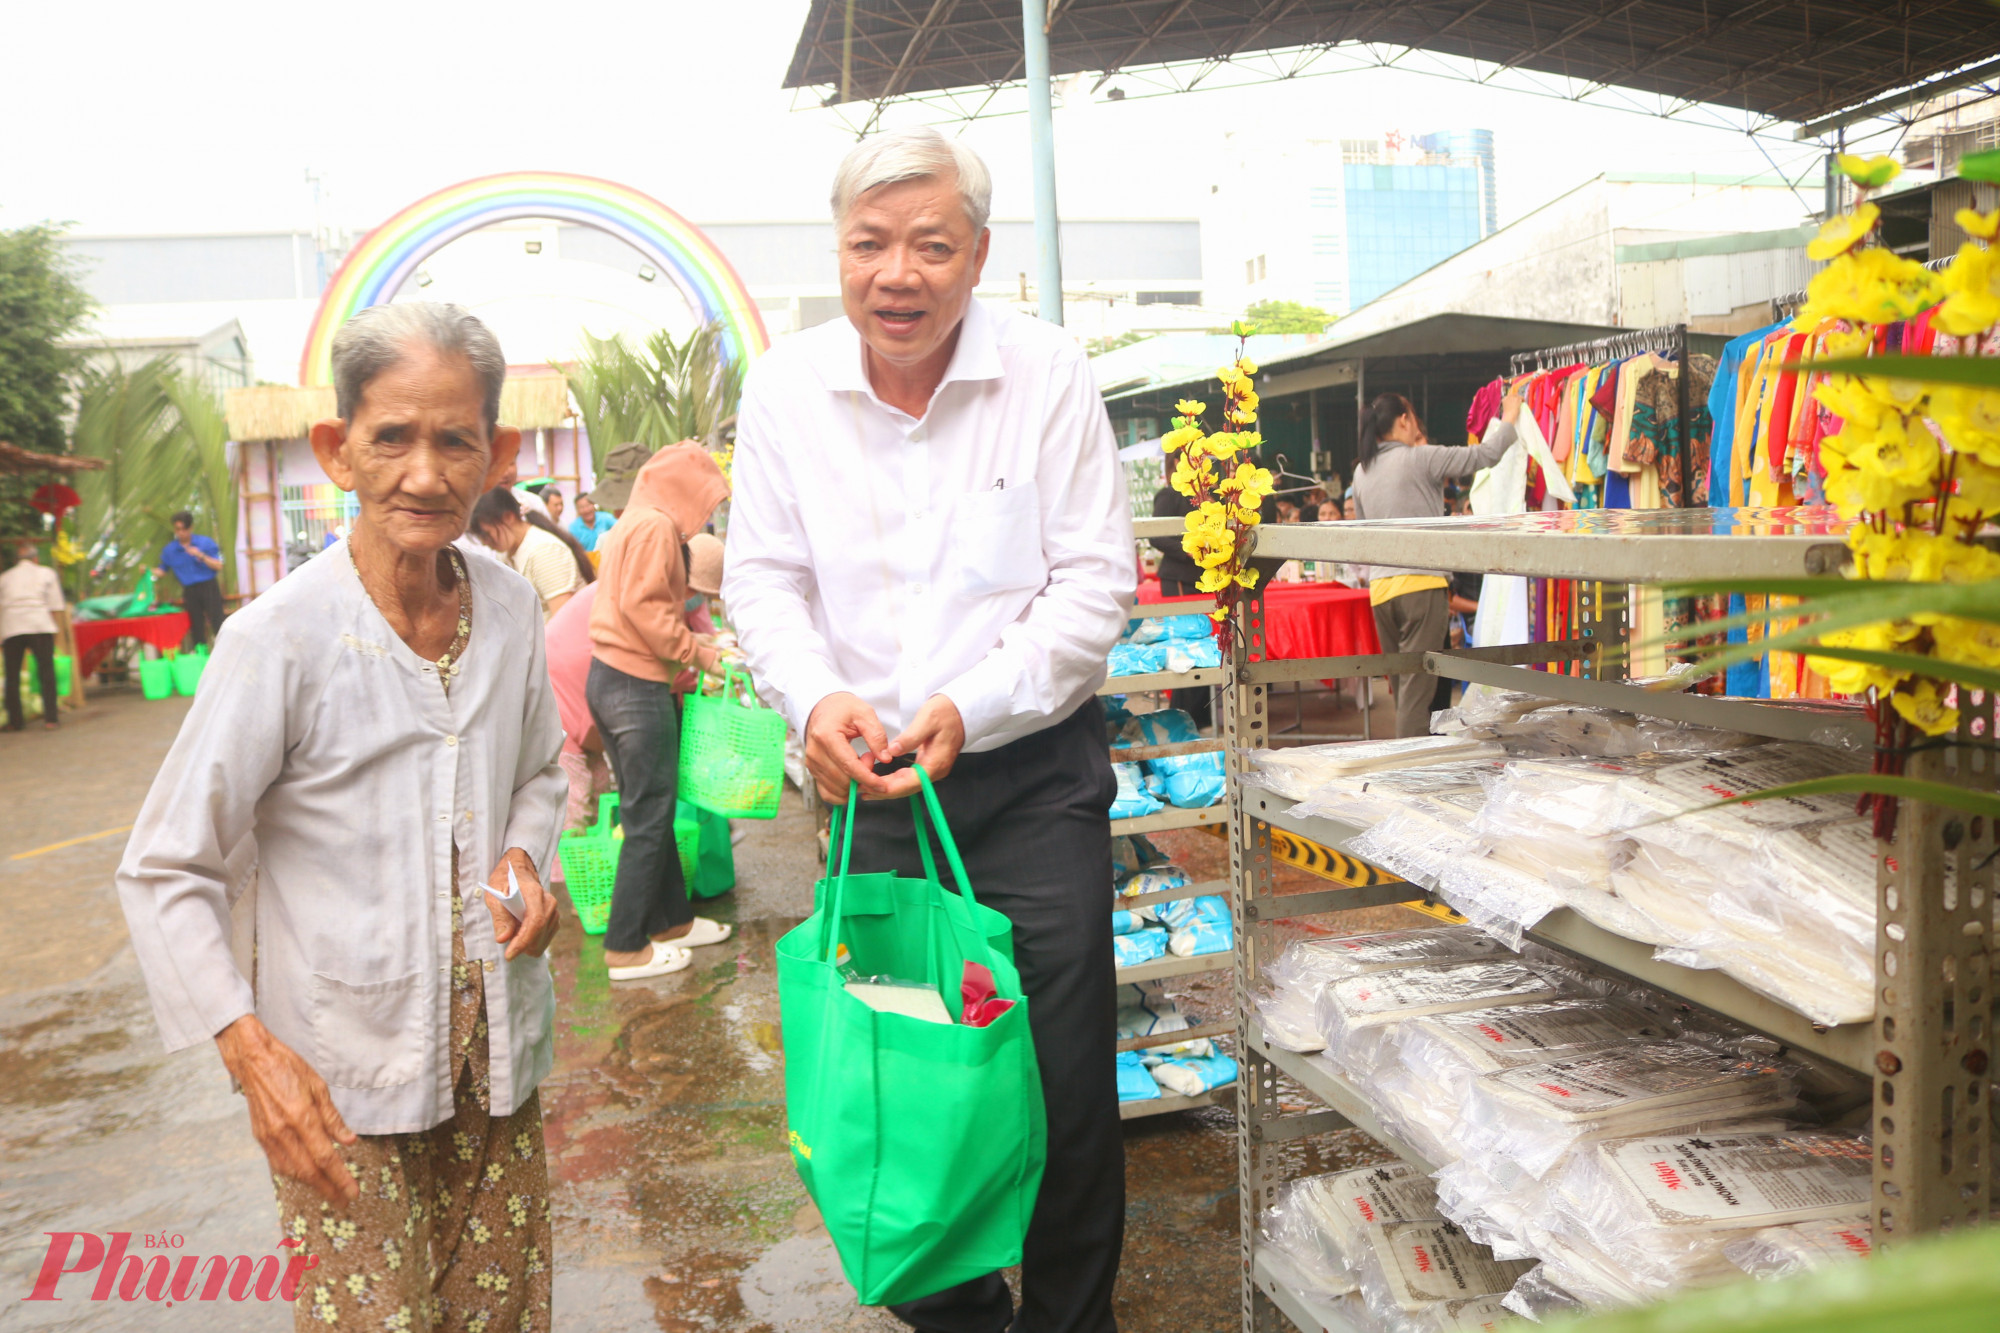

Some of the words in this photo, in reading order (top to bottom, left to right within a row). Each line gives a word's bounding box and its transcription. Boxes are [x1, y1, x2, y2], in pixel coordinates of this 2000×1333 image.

[1649, 1160, 1689, 1191] Mikiri
[1353, 1195, 1379, 1223] Mikiri
[1412, 1244, 1434, 1274] Mikiri
